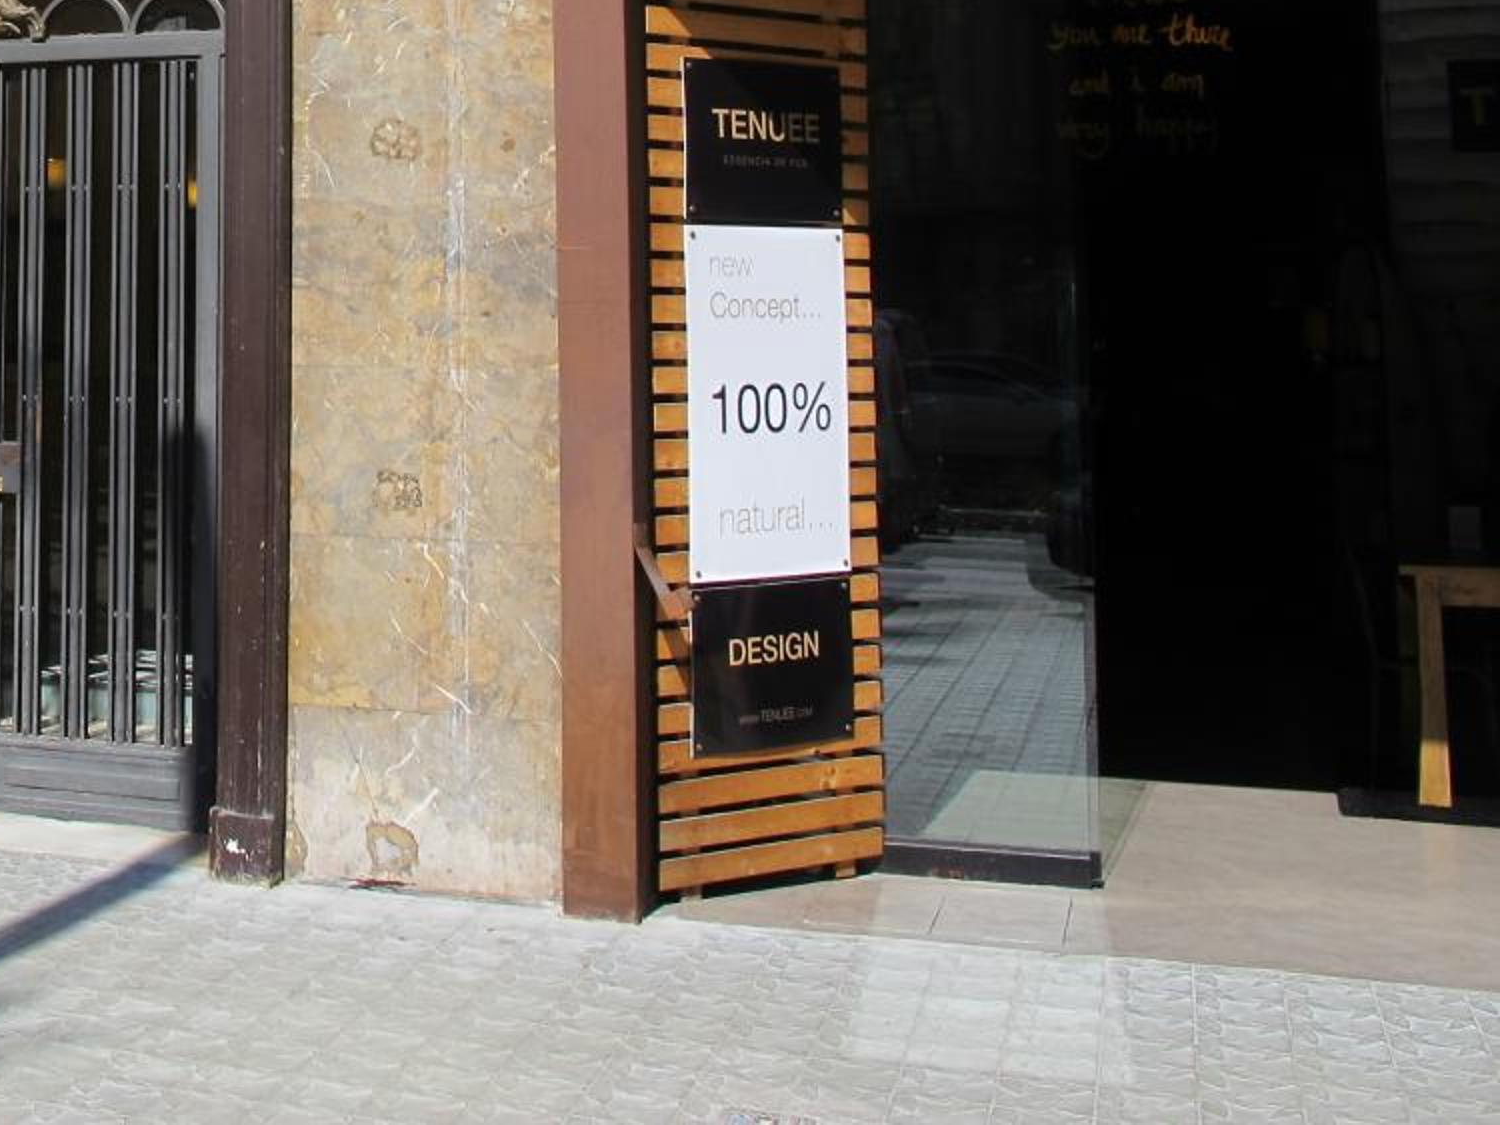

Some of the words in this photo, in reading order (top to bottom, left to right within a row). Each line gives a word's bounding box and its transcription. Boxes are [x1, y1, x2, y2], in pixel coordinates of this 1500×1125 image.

[1046, 21, 1099, 50] you
[711, 108, 820, 144] TENUEE
[709, 254, 754, 277] new
[712, 380, 832, 434] 100%
[728, 630, 820, 666] DESIGN
